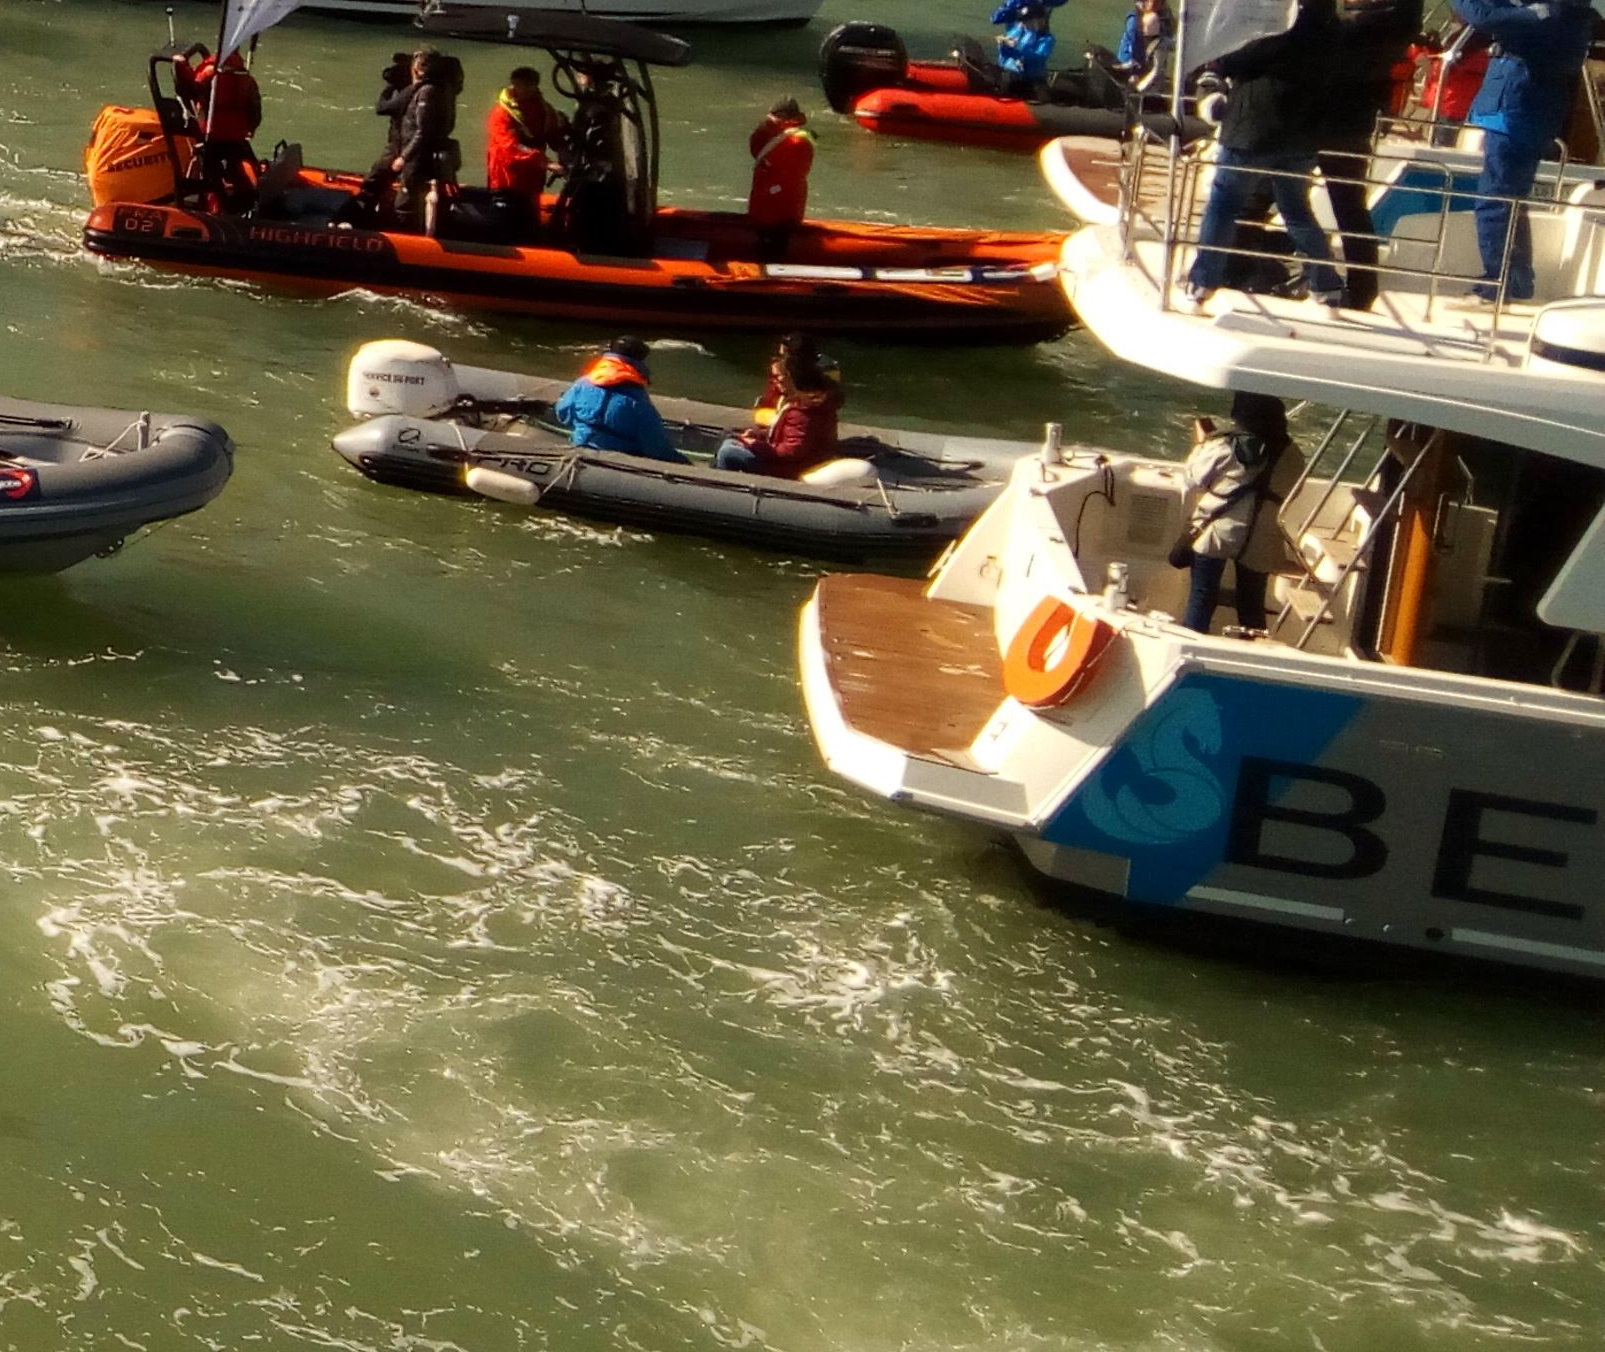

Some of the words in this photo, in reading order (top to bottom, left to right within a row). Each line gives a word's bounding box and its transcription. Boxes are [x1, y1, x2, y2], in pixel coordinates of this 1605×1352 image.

[106, 153, 170, 173] SECURIT
[125, 217, 154, 233] 02
[248, 225, 385, 252] HIGHFIELD
[404, 375, 425, 386] PORT
[1223, 755, 1599, 922] BE
